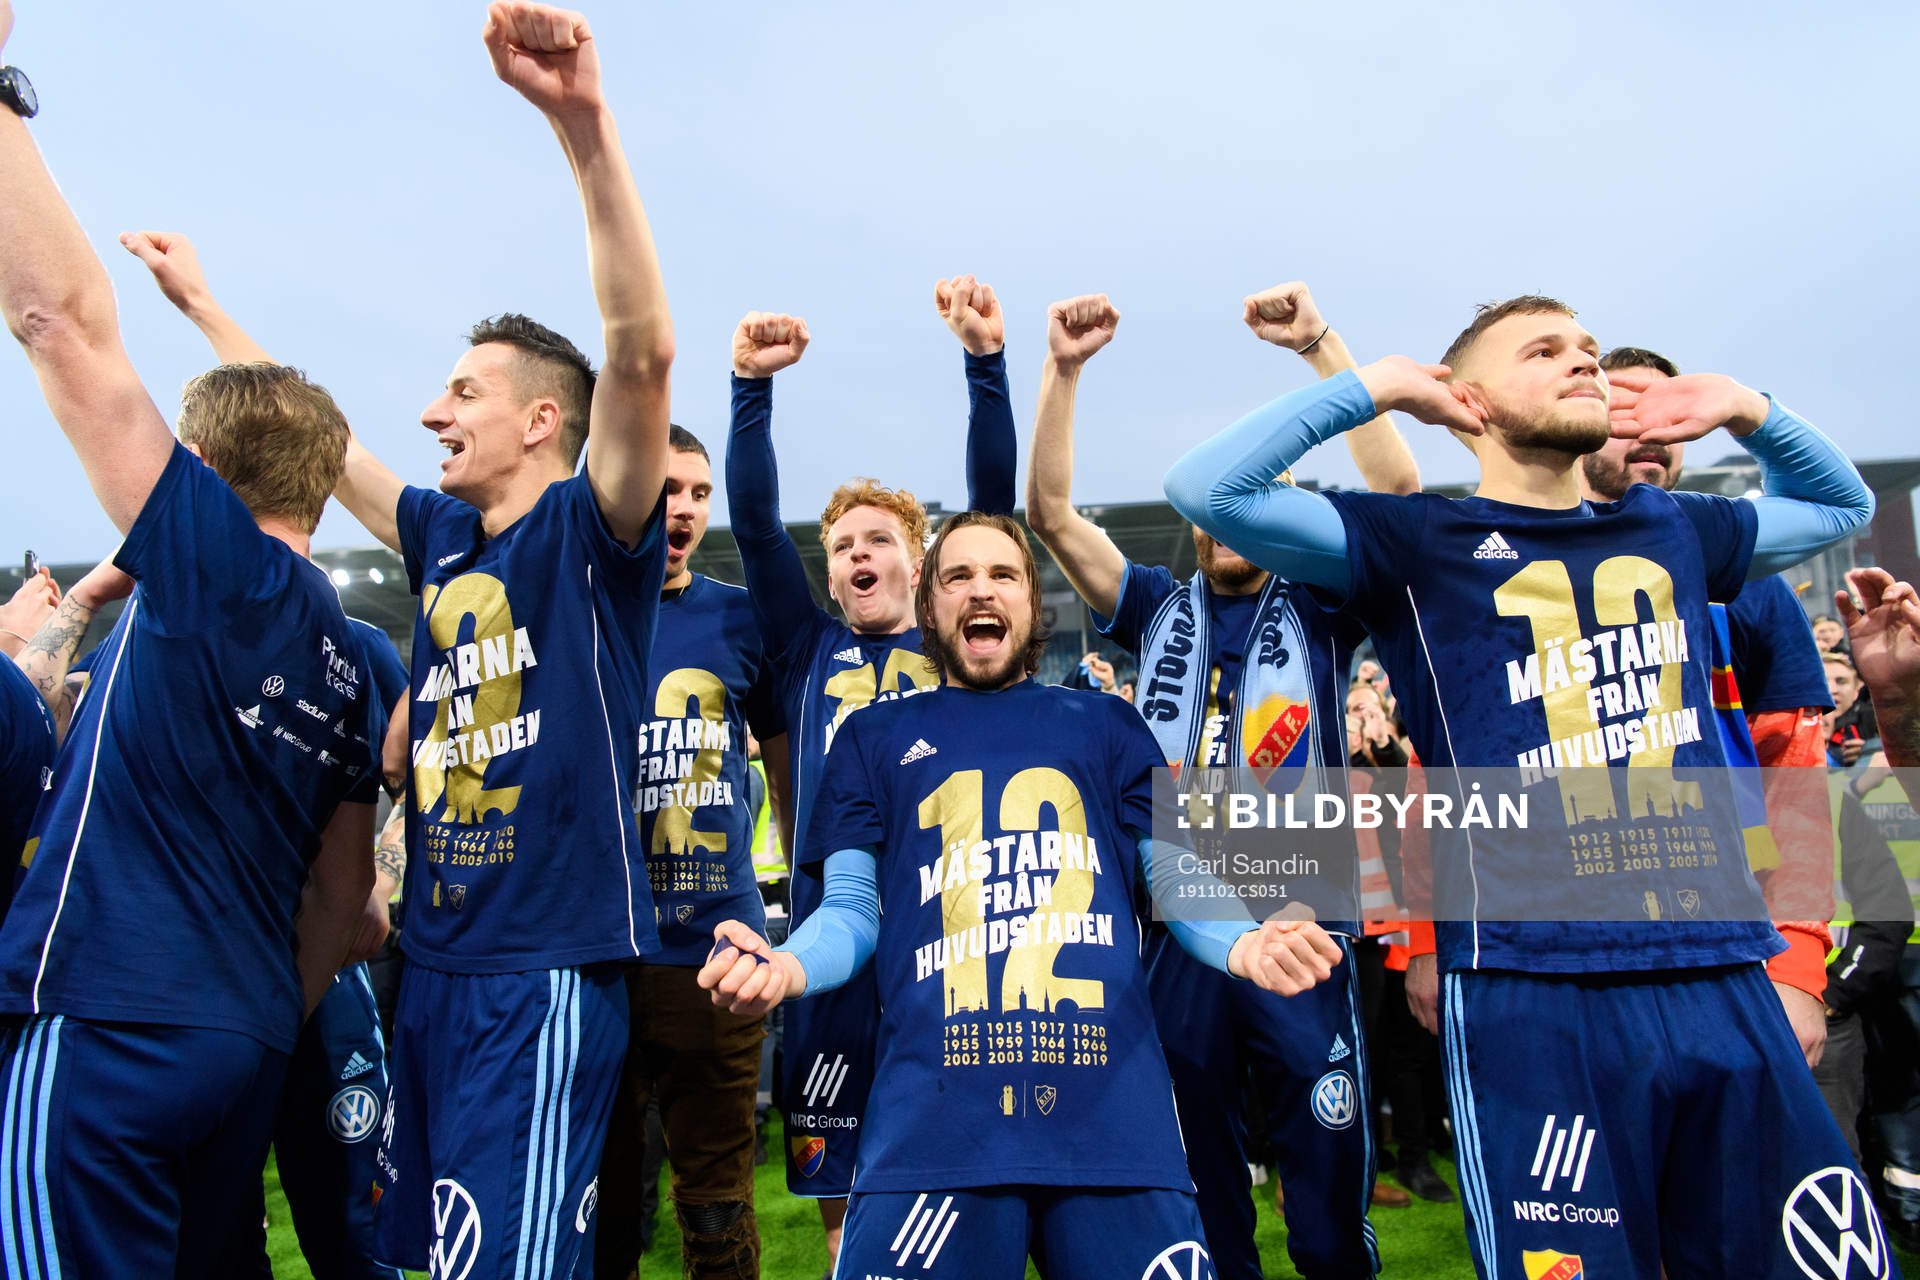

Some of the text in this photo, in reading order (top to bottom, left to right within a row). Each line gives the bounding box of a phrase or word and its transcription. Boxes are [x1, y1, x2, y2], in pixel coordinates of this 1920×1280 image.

[1472, 548, 1519, 560] adidas
[833, 653, 864, 666] adidas
[1505, 619, 1690, 705] MÄSTARNA
[1493, 555, 1704, 828] 12
[1586, 670, 1661, 724] FRÅN
[296, 699, 330, 722] stadium
[638, 717, 731, 755] STARNA
[900, 747, 937, 766] adidas
[453, 840, 486, 853] 1964
[1569, 832, 1611, 847] 1912
[1619, 828, 1656, 842] 1915
[1663, 826, 1692, 839] 1917
[451, 852, 483, 866] 2005
[1571, 846, 1613, 861] 1955
[1620, 842, 1658, 857] 1959
[1665, 841, 1697, 853] 1964
[646, 862, 668, 871] 915
[673, 862, 701, 871] 1917
[918, 831, 1102, 907] MÄSTARNA
[1574, 861, 1615, 876] 2002
[1623, 856, 1661, 871] 2003
[1669, 855, 1699, 868] 2005
[647, 872, 727, 882] 959 1964 1966
[673, 881, 701, 891] 2005
[705, 883, 729, 892] 2019
[918, 767, 1105, 1018] 12
[977, 871, 1052, 917] FRÅN
[915, 912, 1114, 982] HUVUDSTADEN
[944, 1020, 1106, 1038] 1912 1915 1917 1920
[944, 1035, 1107, 1052] 1955 1959 1964 1966
[943, 1050, 1108, 1067] 2002 2003 2005 2019
[340, 1061, 374, 1081] adidas
[790, 1112, 858, 1130] NRC Group
[1513, 1200, 1619, 1228] NRC Group
